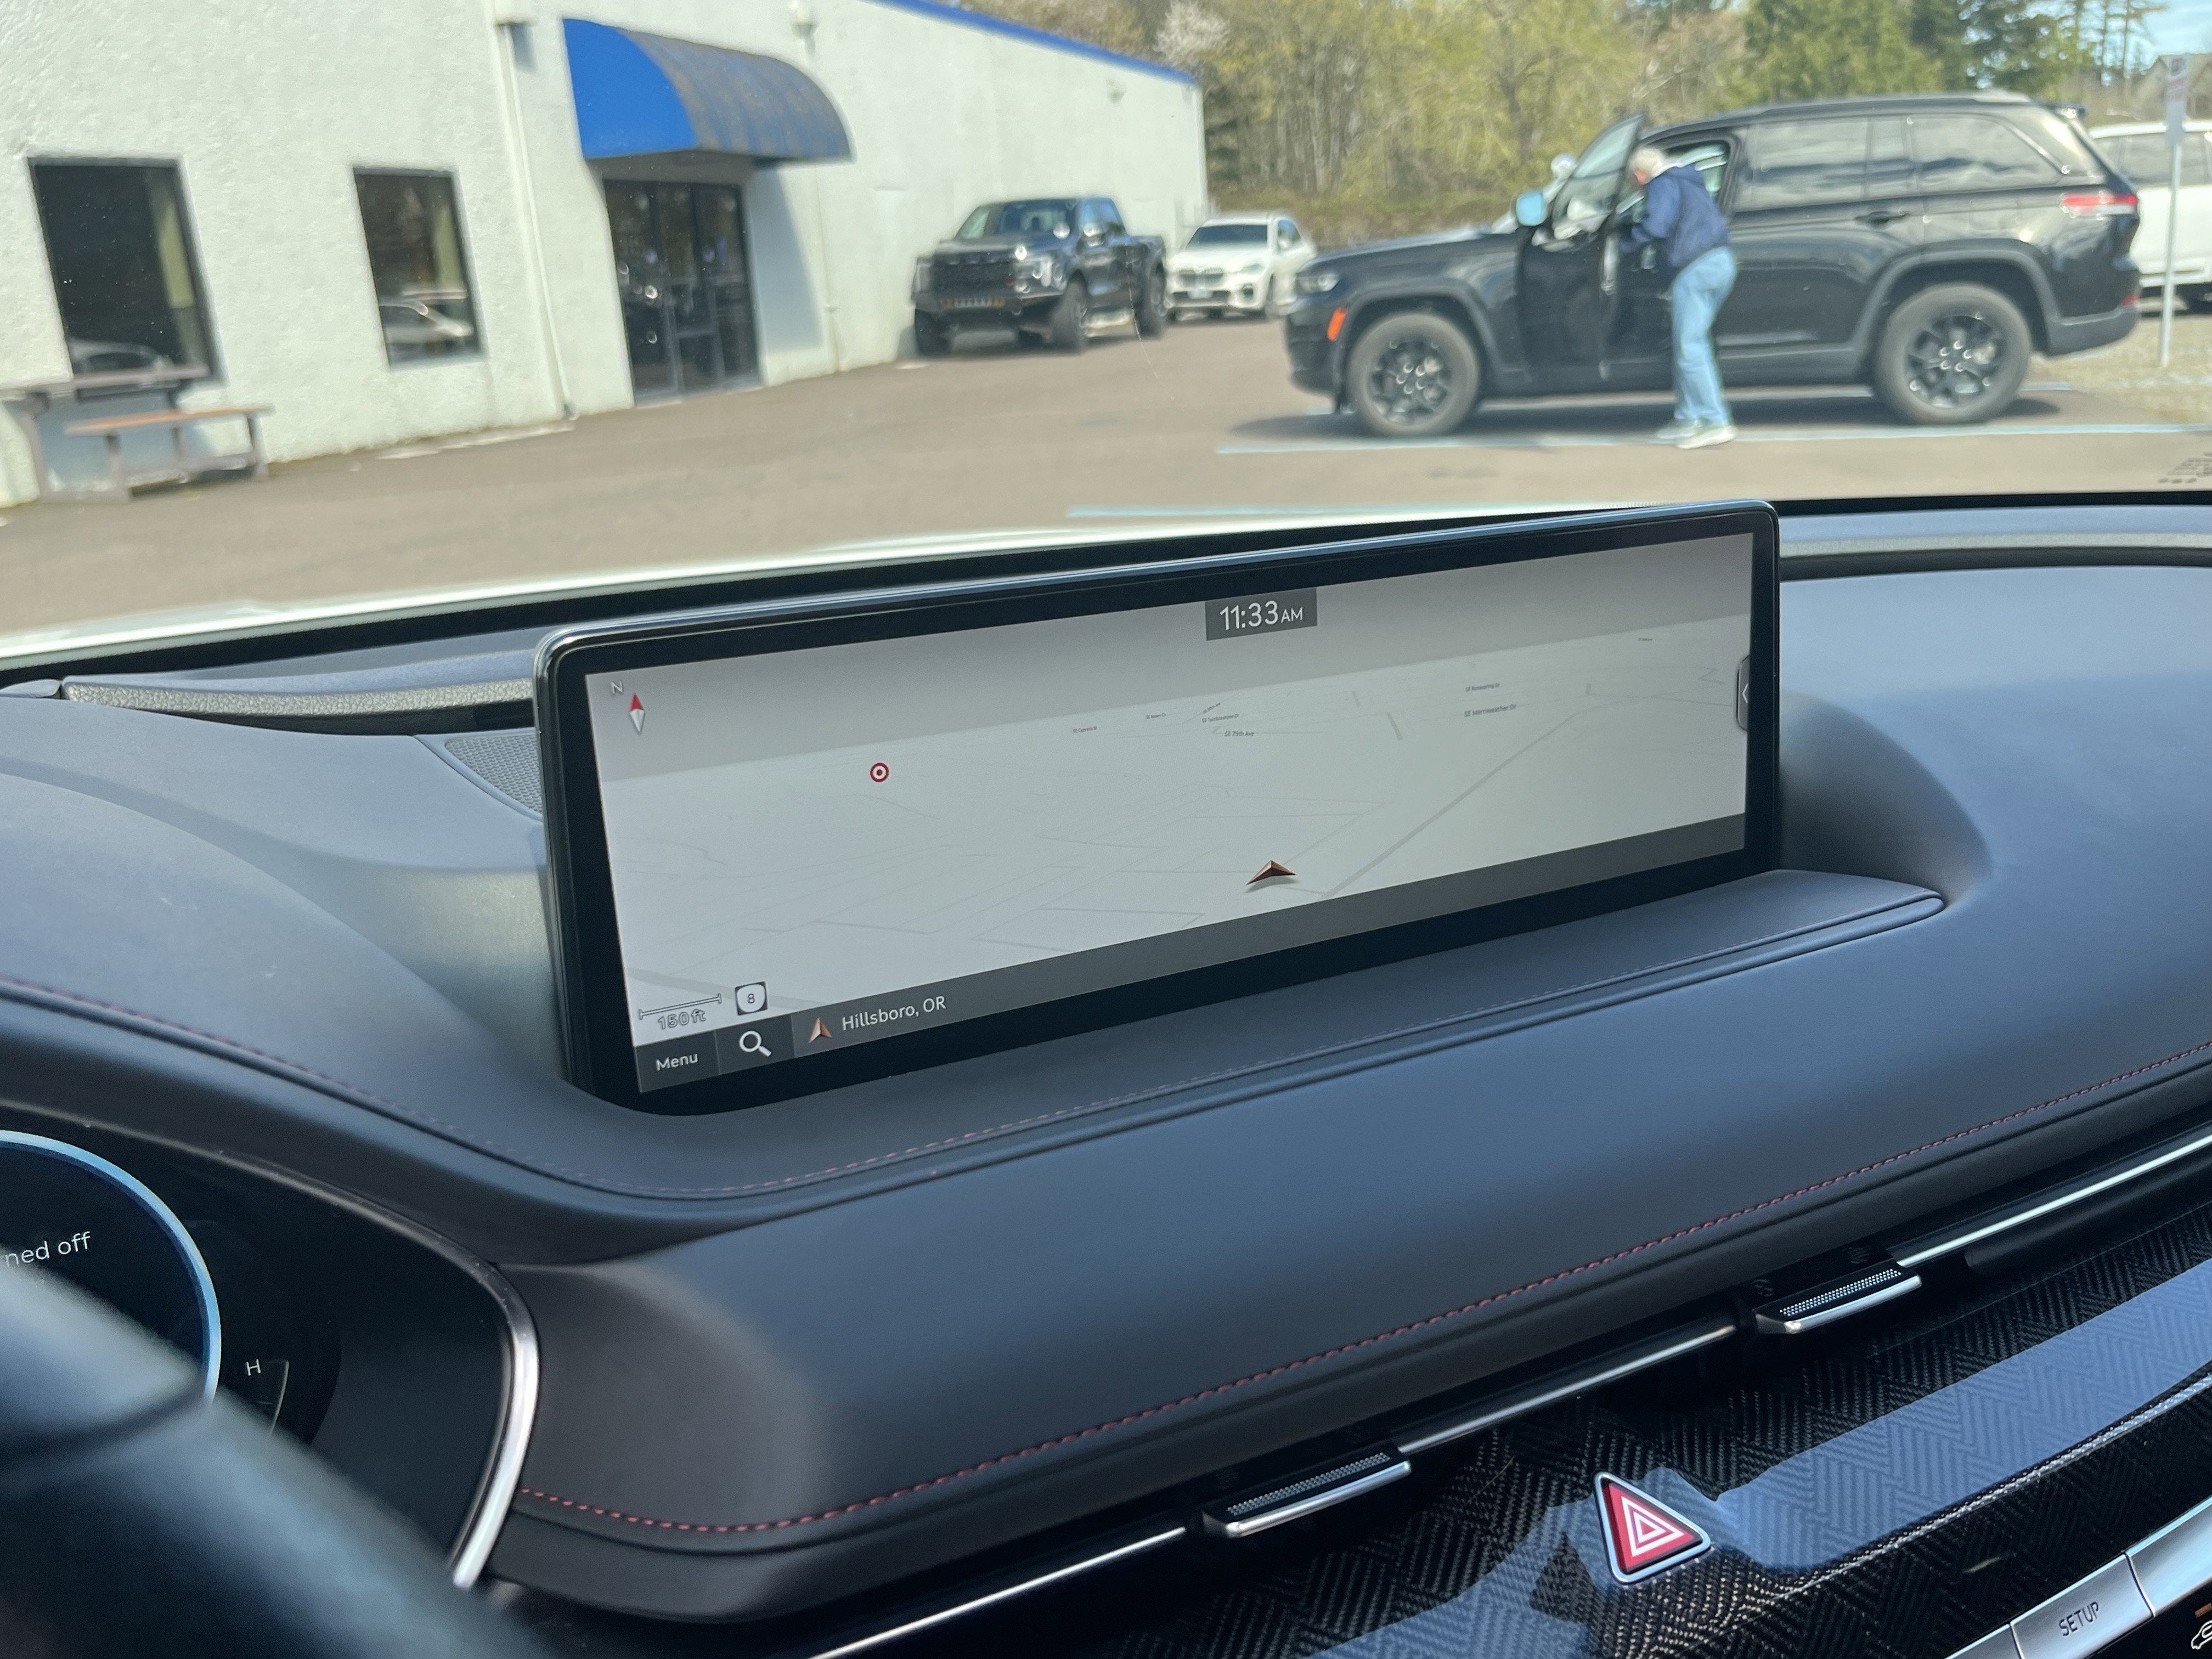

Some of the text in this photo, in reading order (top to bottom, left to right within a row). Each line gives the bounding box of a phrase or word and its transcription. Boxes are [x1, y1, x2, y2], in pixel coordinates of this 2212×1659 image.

[610, 680, 624, 695] N
[747, 994, 755, 1004] 8
[842, 996, 946, 1031] Hillsboro, OR
[656, 1053, 699, 1071] Menu
[58, 1231, 91, 1255] off
[245, 1359, 262, 1376] H
[2058, 1601, 2100, 1637] SETUP
